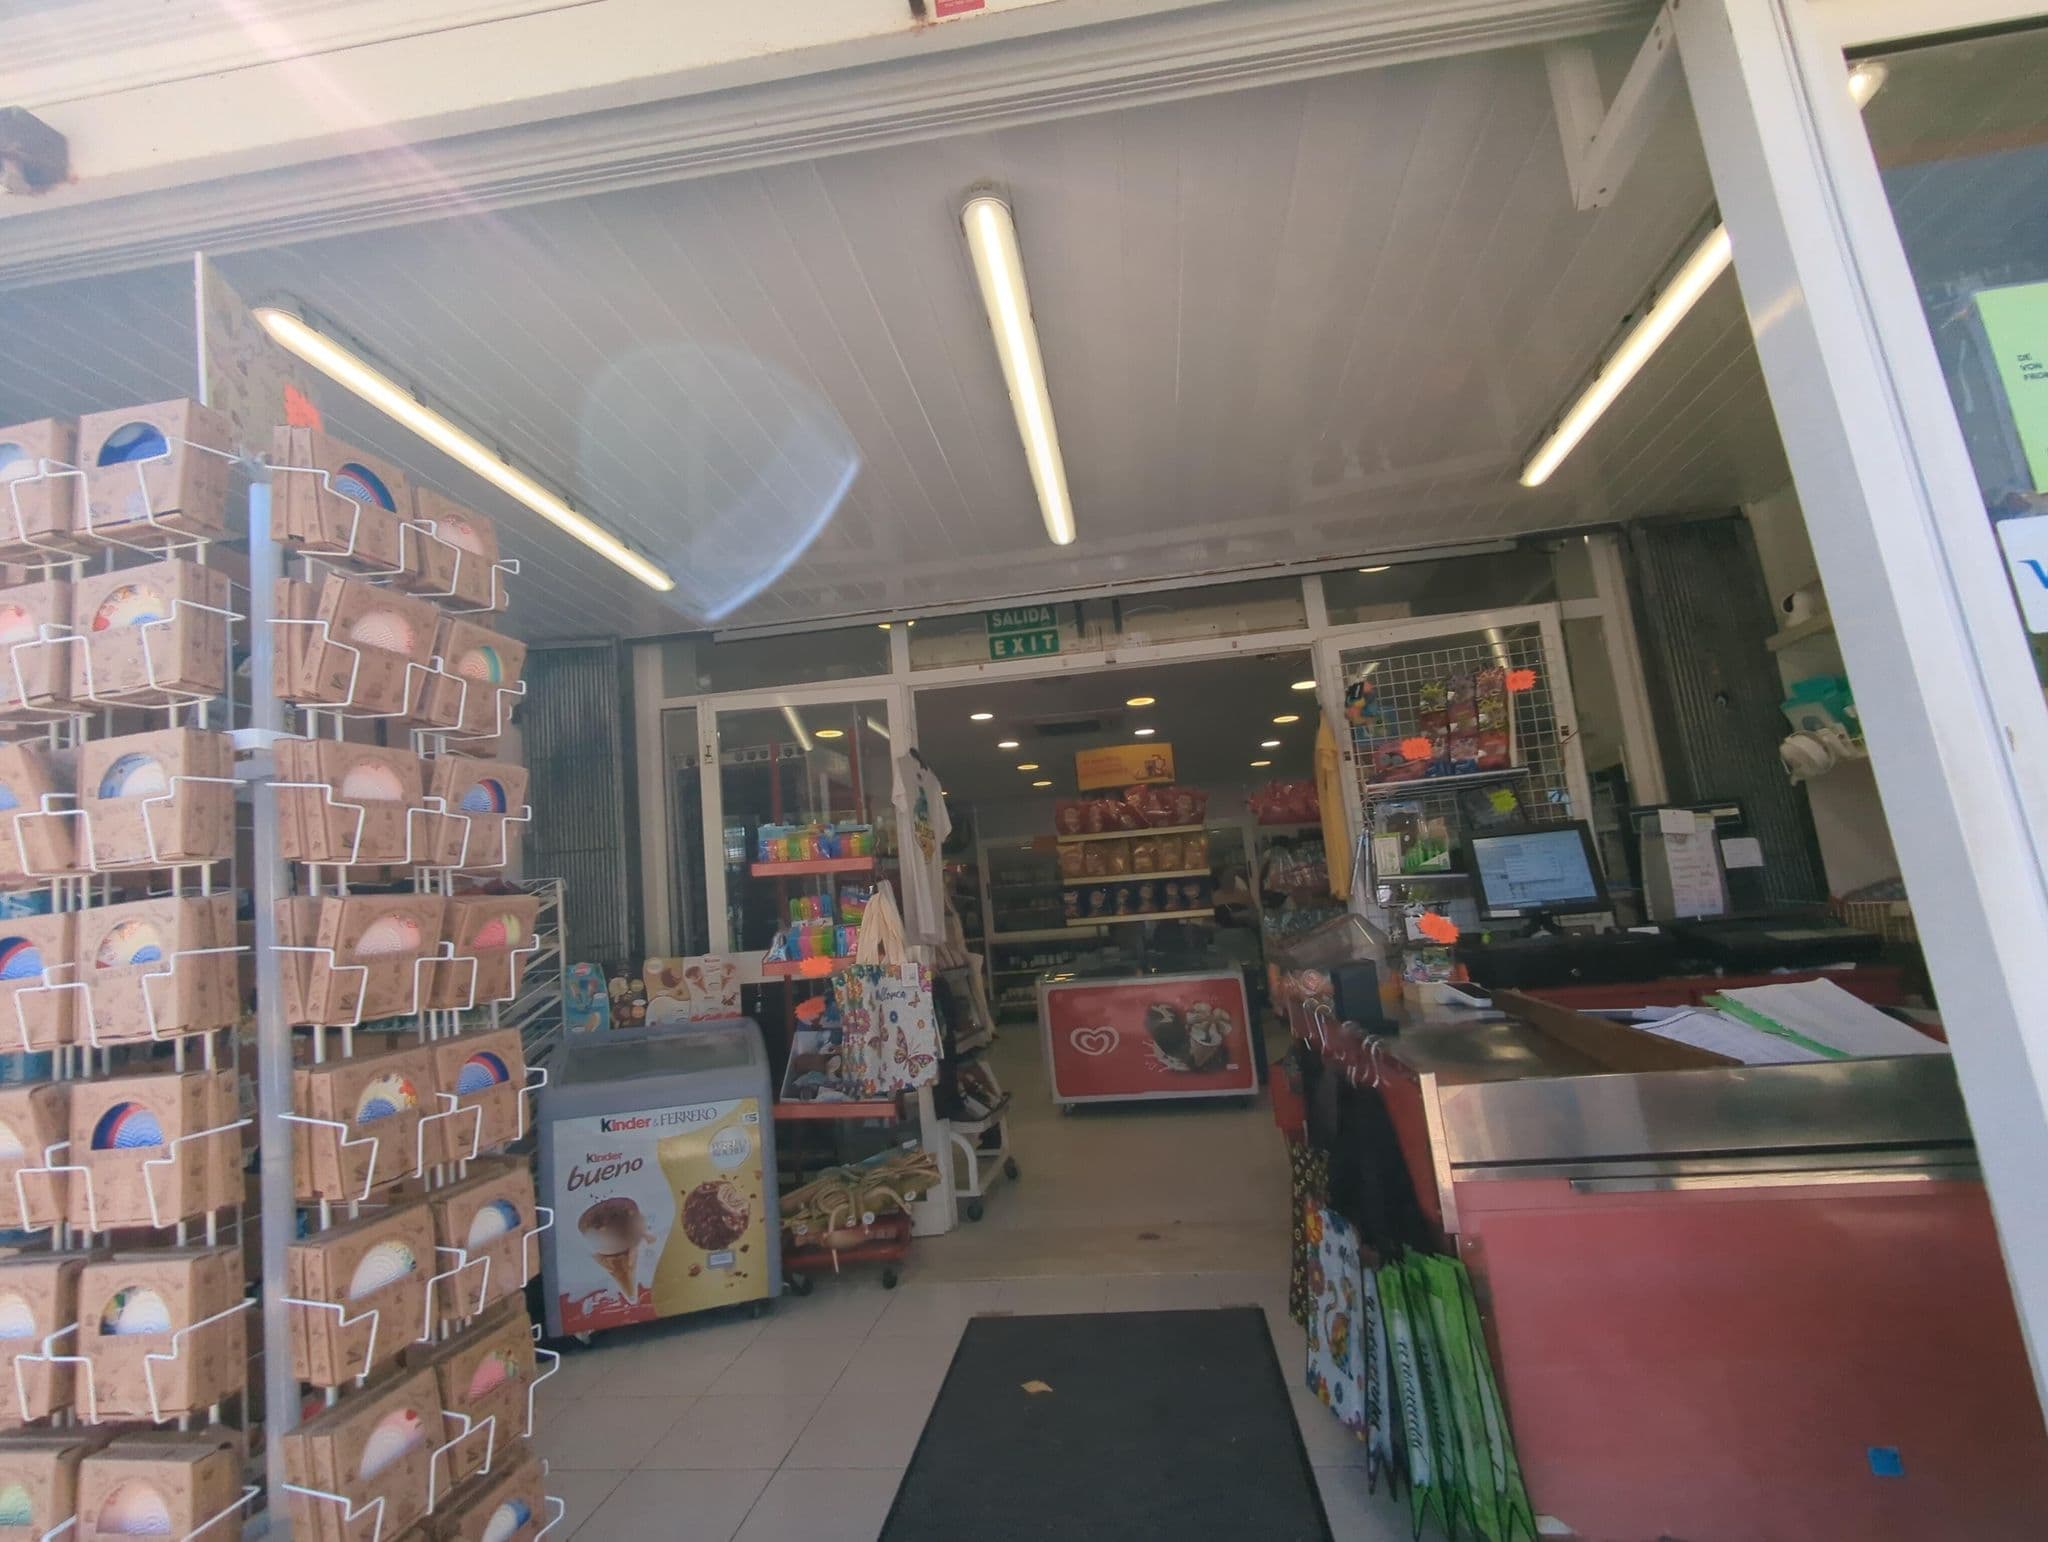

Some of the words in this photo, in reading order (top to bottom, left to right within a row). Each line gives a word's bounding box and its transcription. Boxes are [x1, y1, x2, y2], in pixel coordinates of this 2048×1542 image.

[992, 607, 1050, 626] SALIDA
[995, 634, 1054, 655] EXIT
[660, 1108, 717, 1126] FERRERO
[567, 1157, 643, 1191] bueno
